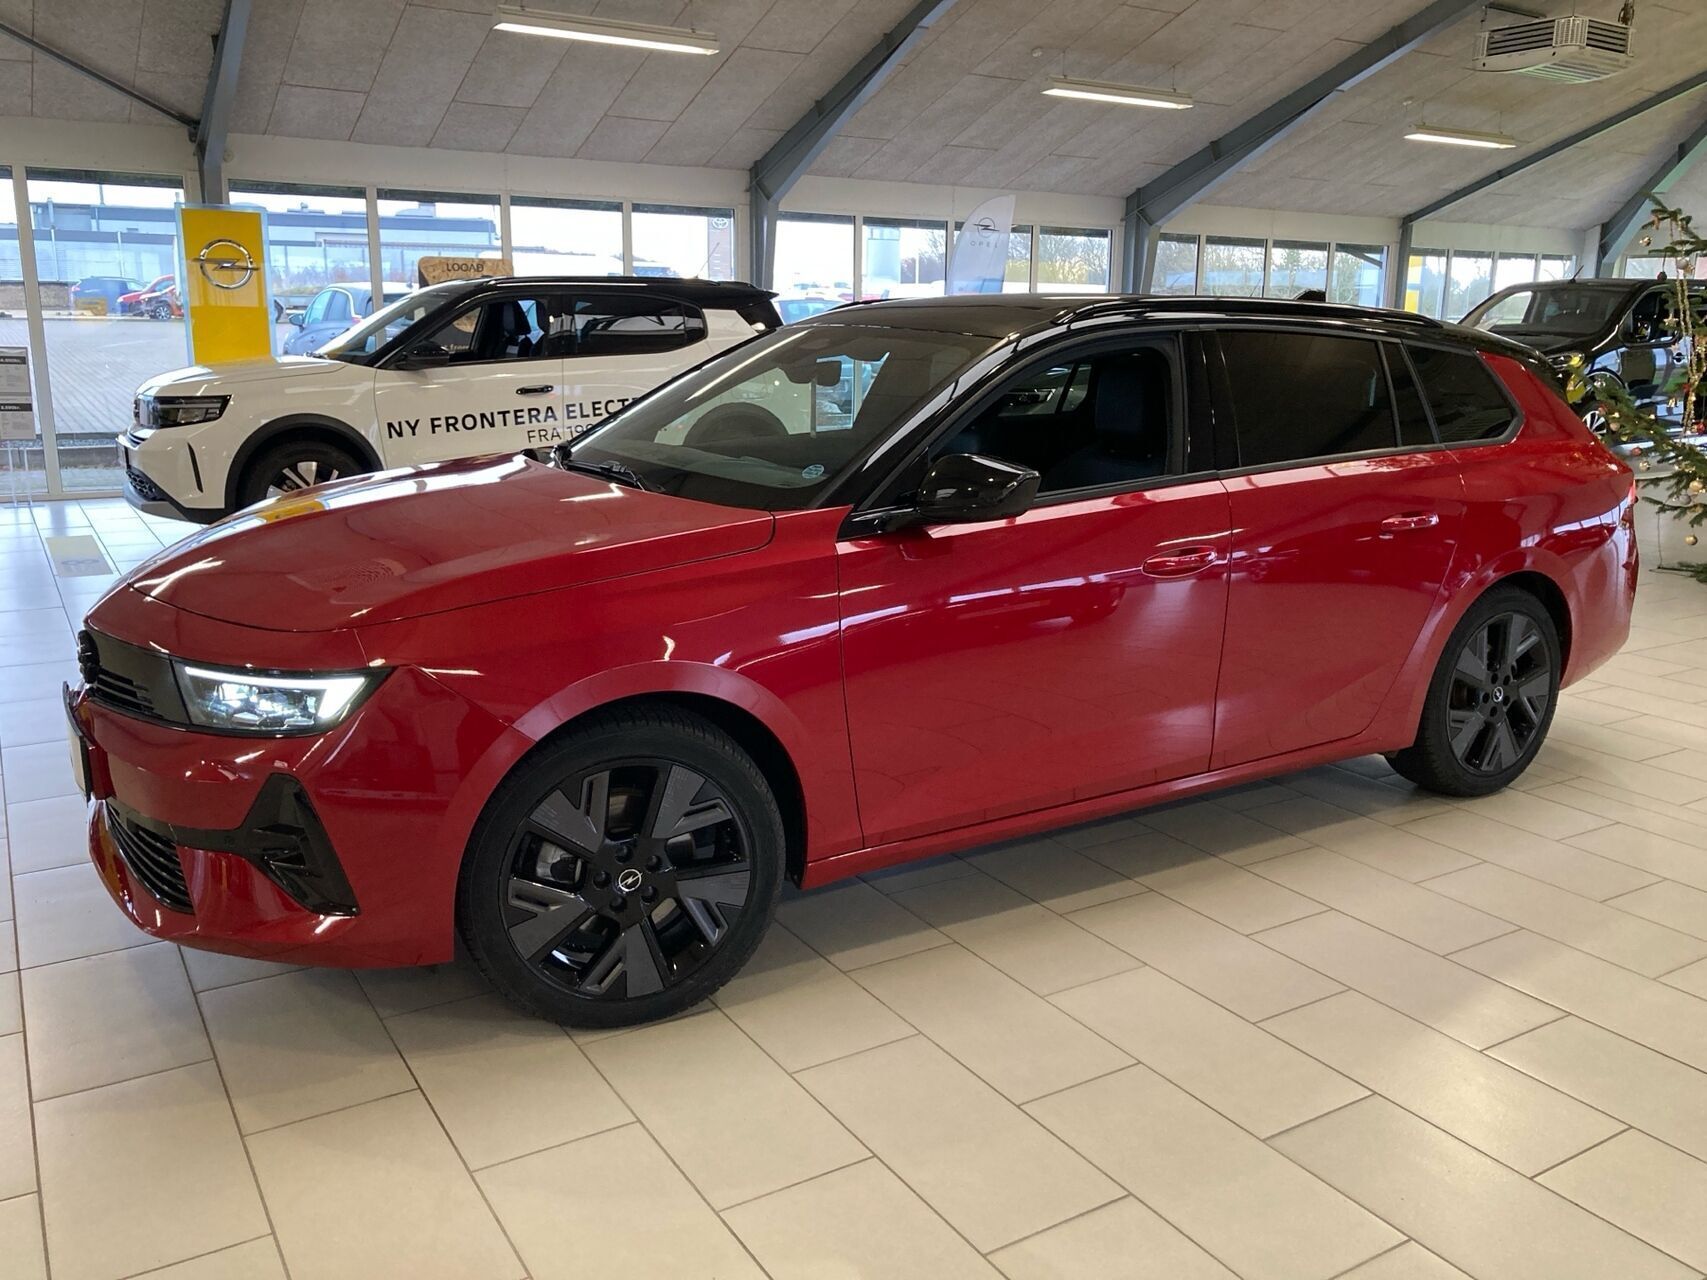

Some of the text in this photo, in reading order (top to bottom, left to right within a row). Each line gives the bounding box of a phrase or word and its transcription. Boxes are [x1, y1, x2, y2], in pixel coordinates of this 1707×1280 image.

[386, 397, 639, 440] NY FRONTERA ELECT
[527, 427, 562, 443] FRA
